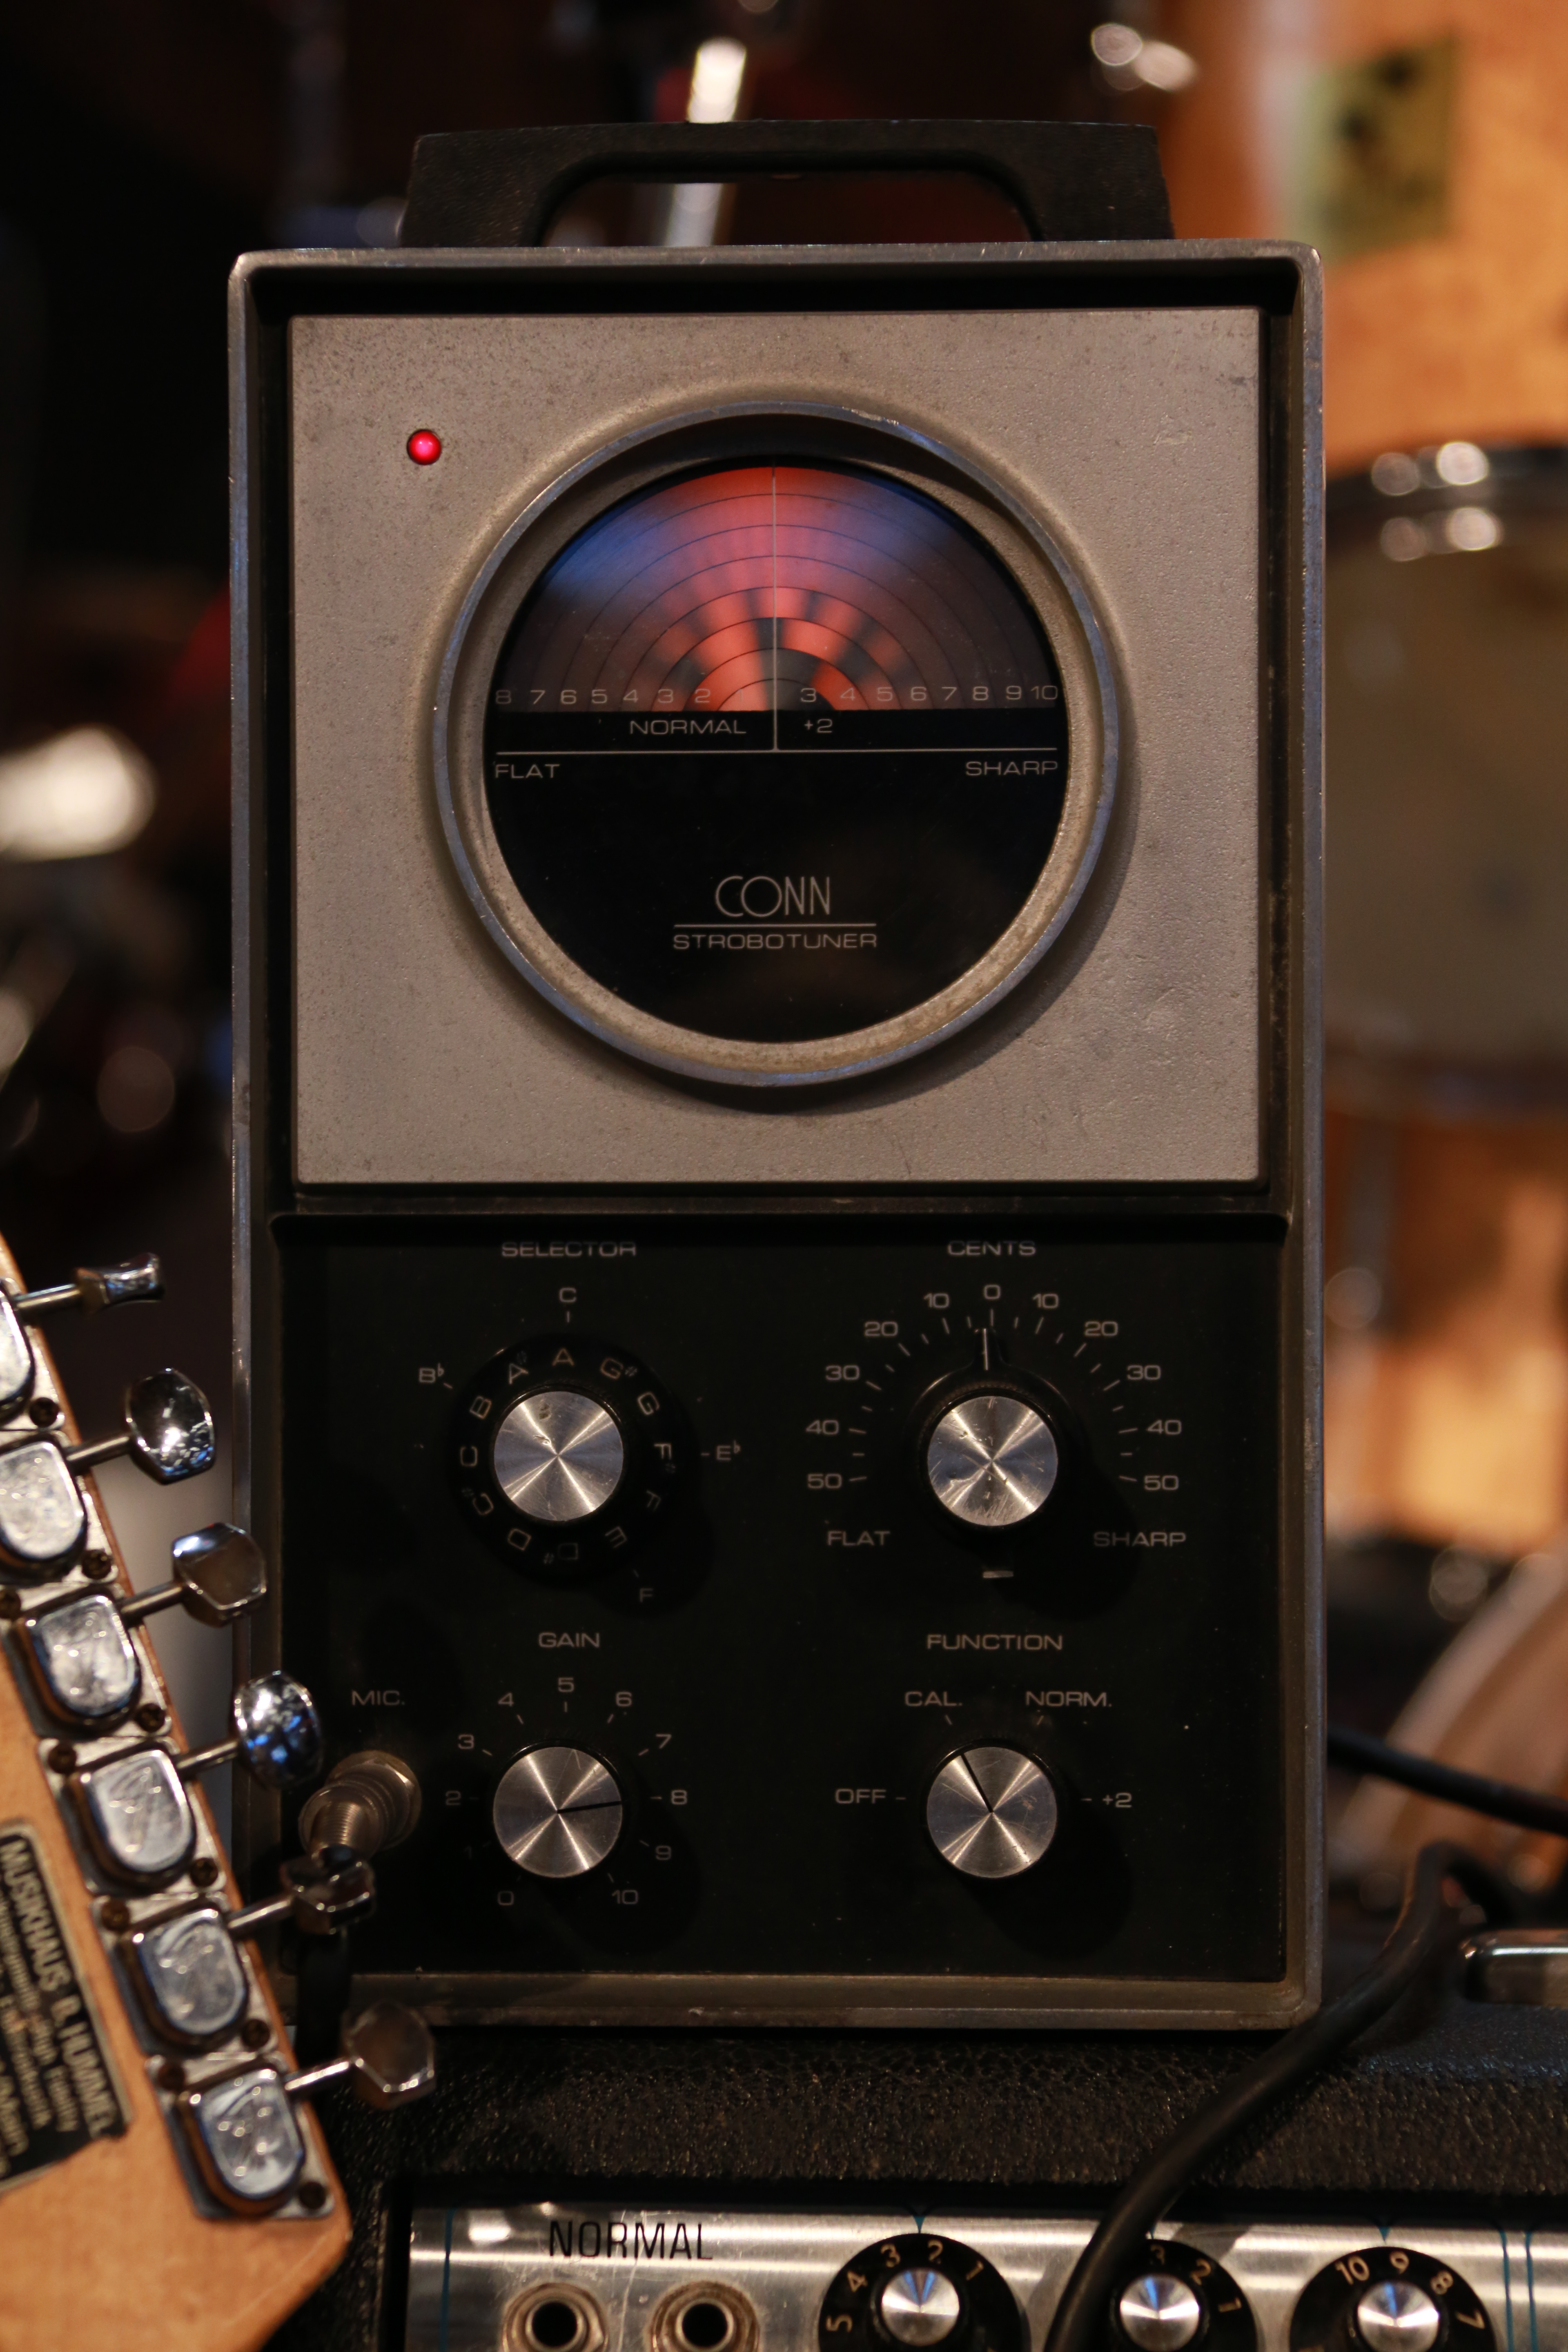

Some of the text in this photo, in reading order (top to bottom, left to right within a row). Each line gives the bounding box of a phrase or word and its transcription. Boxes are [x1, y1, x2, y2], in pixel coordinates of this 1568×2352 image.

[495, 690, 512, 705] 8
[530, 690, 546, 704] 7
[560, 690, 577, 704] 6
[591, 689, 608, 704] 5
[623, 689, 639, 703] 4
[657, 688, 674, 703] 3
[694, 688, 711, 703] 2
[800, 685, 1058, 702] 3 4 5 6 7 8 9 10
[630, 719, 746, 735] NORMAL
[804, 719, 833, 733] +2
[495, 764, 560, 779] FLAT
[966, 761, 1058, 776] SHARP
[715, 875, 830, 918] CONN
[673, 933, 877, 949] STROBOTUNER
[502, 1241, 637, 1258] SELECTOR
[948, 1241, 1036, 1256] CENTS
[559, 1287, 577, 1304] C
[983, 1284, 1001, 1299] 0
[924, 1293, 950, 1308] 10
[1032, 1293, 1059, 1308] 10
[864, 1321, 898, 1336] 20
[1085, 1321, 1118, 1336] 20
[552, 1348, 575, 1366] A
[825, 1365, 860, 1381] 30
[1127, 1365, 1161, 1381] 30
[469, 1395, 492, 1420] B
[637, 1391, 660, 1416] G
[806, 1419, 840, 1435] 40
[1147, 1419, 1182, 1435] 40
[807, 1473, 842, 1489] 50
[1144, 1475, 1179, 1490] 50
[507, 1528, 532, 1551] D
[605, 1526, 628, 1548] E
[827, 1530, 891, 1546] FLAT
[1094, 1531, 1186, 1547] SHARP
[639, 1588, 654, 1603] F
[539, 1632, 600, 1648] GAIN
[927, 1635, 1062, 1650] FUNCTION
[558, 1677, 574, 1693] 5
[352, 1690, 405, 1706] MIC.
[498, 1693, 514, 1707] 4
[616, 1692, 633, 1707] 6
[904, 1691, 963, 1706] CAL.
[1026, 1691, 1112, 1707] NORM.
[458, 1734, 475, 1749] 3
[655, 1734, 672, 1749] 7
[445, 1790, 461, 1805] 2
[671, 1790, 688, 1805] 8
[835, 1789, 886, 1804] OFF
[1102, 1792, 1132, 1808] +2
[655, 1845, 672, 1861] 9
[497, 1891, 514, 1906] 0
[611, 1889, 639, 1904] 10
[0, 1840, 72, 1993] MUSIKHAUS
[548, 2220, 713, 2260] NORMAL
[880, 2244, 900, 2267] 3
[928, 2240, 943, 2264] 2
[965, 2260, 984, 2281] 1
[1334, 2256, 1371, 2285] 10
[1389, 2251, 1411, 2274] 9
[1191, 2258, 1212, 2285] 2
[846, 2270, 868, 2292] 4
[1429, 2270, 1454, 2295] 8
[1218, 2298, 1242, 2314] 1
[826, 2314, 853, 2332] 5
[1456, 2309, 1486, 2330] 7
